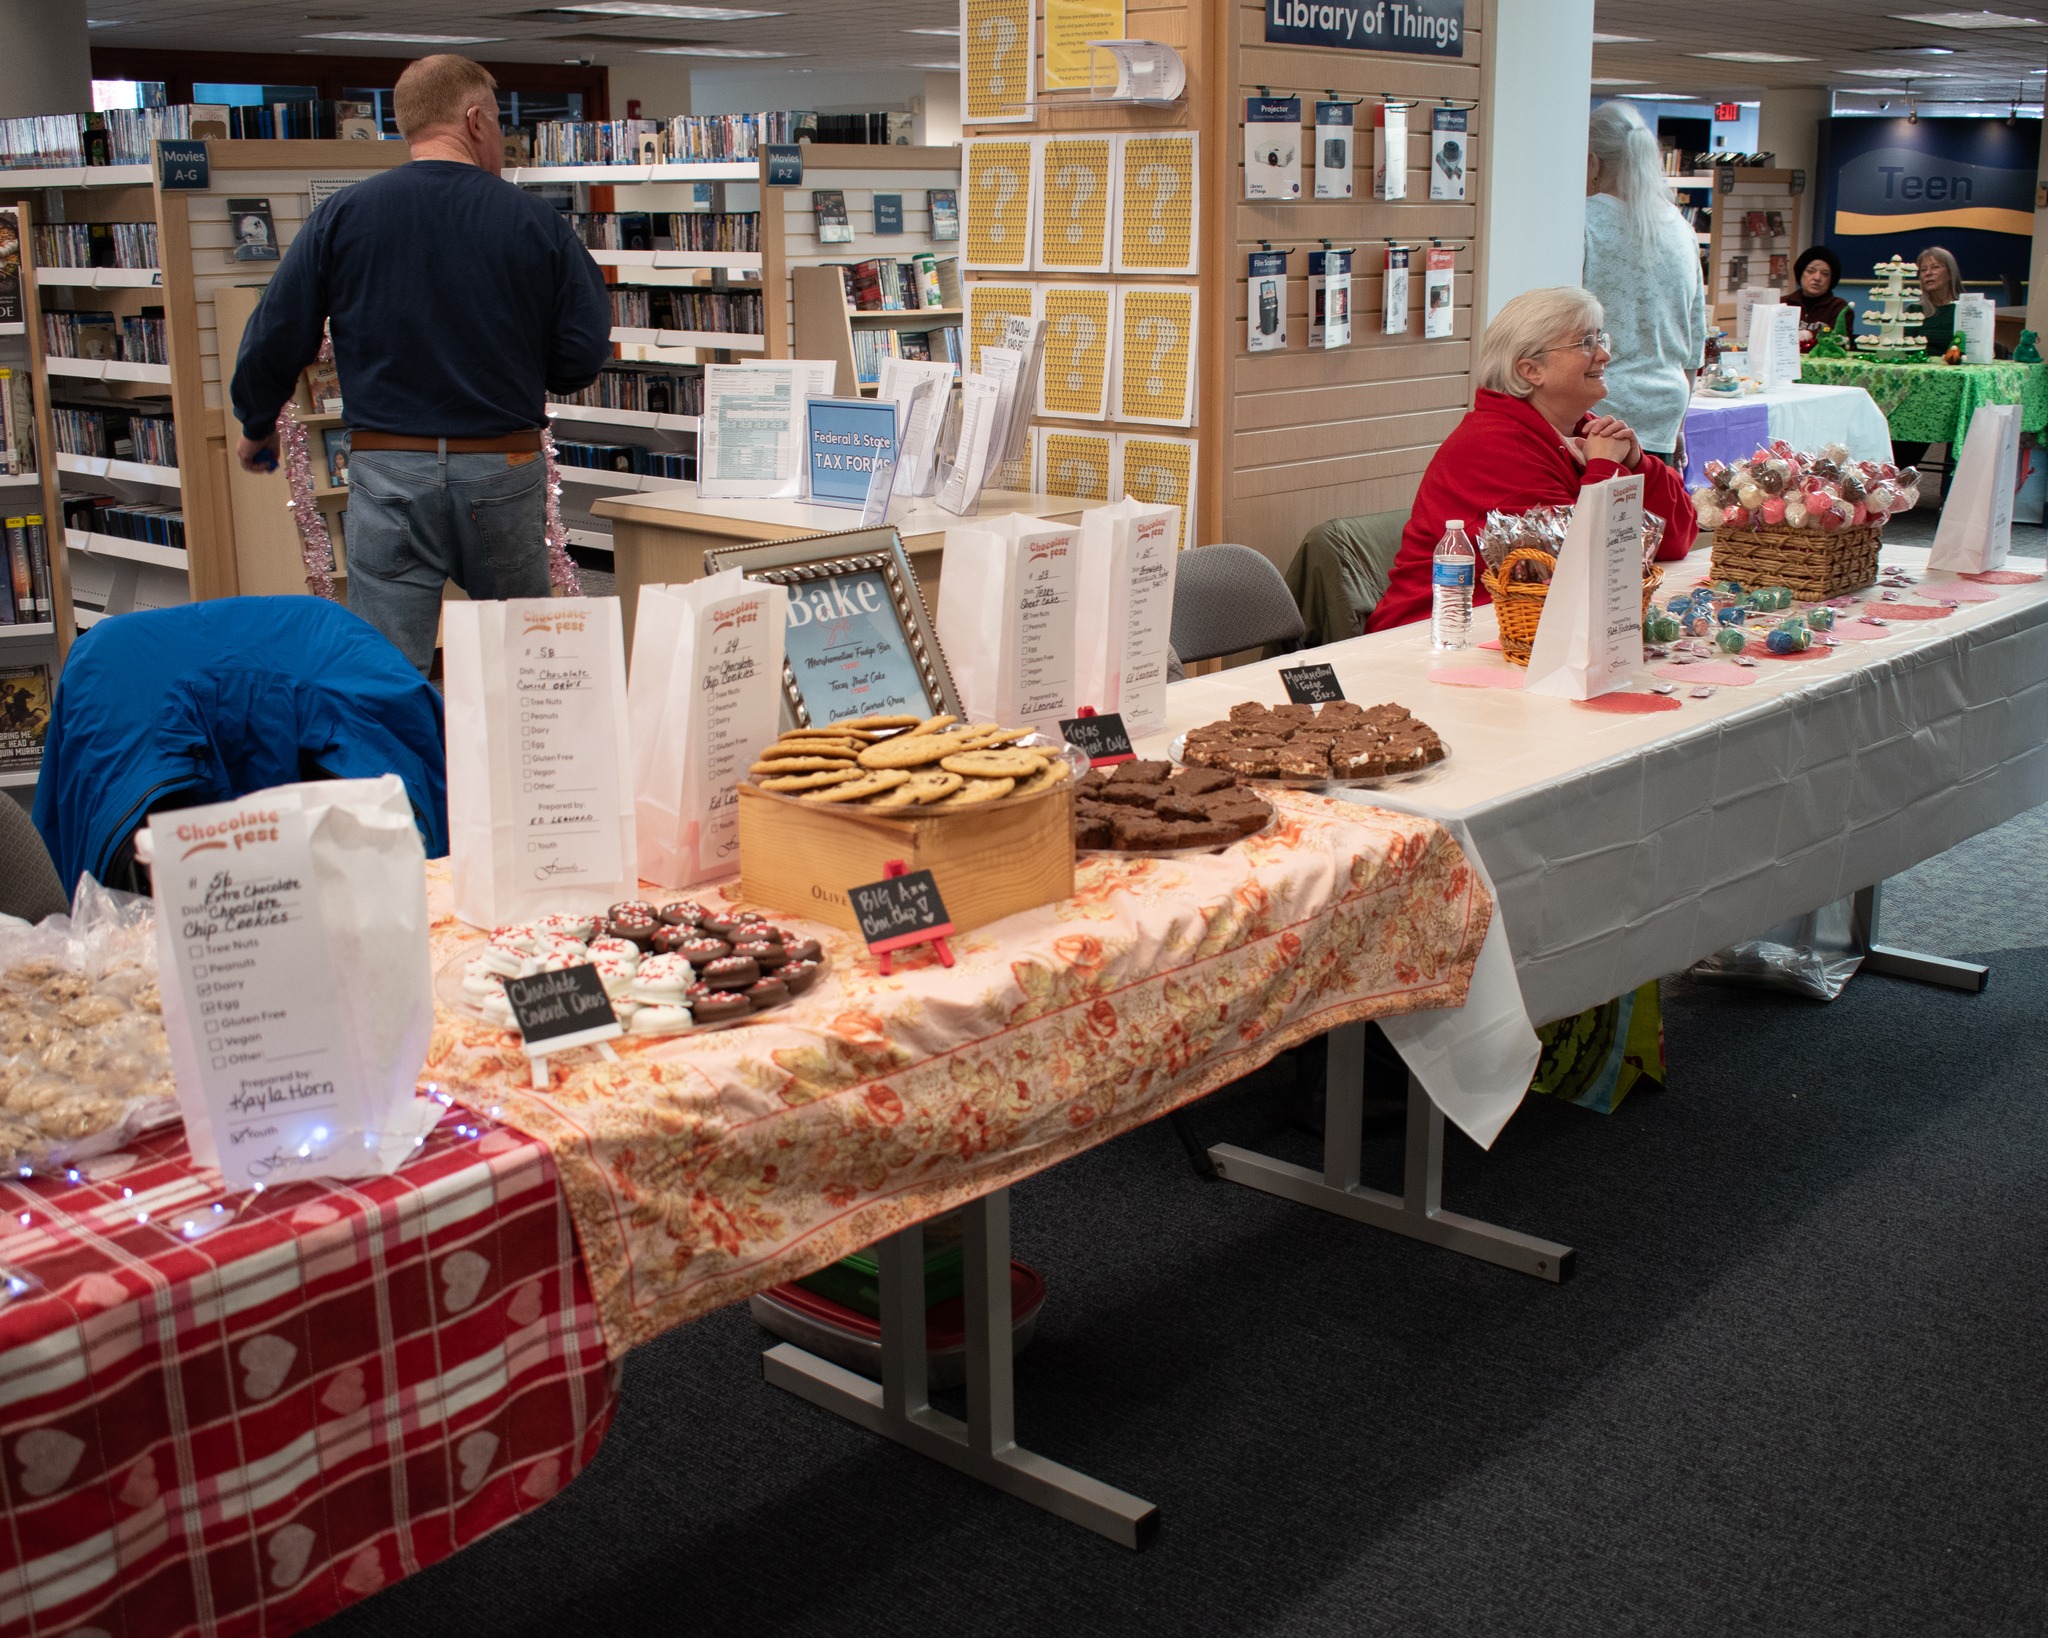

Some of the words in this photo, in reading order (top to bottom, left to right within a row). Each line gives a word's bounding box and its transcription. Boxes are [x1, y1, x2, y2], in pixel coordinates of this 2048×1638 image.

[1273, 0, 1358, 40] Library
[1363, 2, 1384, 34] of
[1391, 4, 1458, 48] Things
[1261, 105, 1288, 114] Projector
[1719, 103, 1737, 121] EXIT
[164, 150, 206, 162] Movies
[771, 153, 800, 163] Movies
[174, 169, 198, 181] A-G
[778, 169, 793, 179] P-Z
[1878, 166, 1973, 201] Teen
[880, 205, 896, 214] Binge
[880, 216, 897, 224] Boxes
[1264, 259, 1282, 267] Scanner
[1010, 320, 1024, 336] 1040
[318, 367, 335, 376] SOLO
[814, 430, 851, 445] Federal
[853, 433, 862, 447] &
[863, 433, 891, 449] State
[815, 452, 843, 470] TAX
[846, 455, 891, 473] FORMS
[1138, 518, 1166, 533] Chocolate
[1029, 537, 1070, 552] Chocolate
[786, 577, 881, 628] Bake
[523, 609, 588, 622] Chocolate
[713, 600, 760, 622] Chocolate
[736, 612, 757, 628] fest
[725, 638, 740, 654] 24
[855, 646, 876, 660] Fudge
[876, 642, 891, 654] Bar
[520, 667, 535, 675] Dish:
[540, 669, 590, 679] Chocolate
[720, 657, 754, 675] Chocolate
[720, 669, 755, 685] Cookies
[828, 680, 849, 692] Texas
[870, 671, 887, 683] Cake
[728, 688, 740, 696] Nuts
[1299, 680, 1325, 692] Fudge
[530, 698, 545, 706] Tree
[545, 697, 562, 706] Nuts
[1029, 692, 1052, 701] Prepared
[1311, 690, 1336, 702] Bars
[716, 702, 737, 712] Peanuts
[860, 699, 885, 714] Covered
[887, 695, 906, 707] Oreos
[1020, 703, 1032, 715] Ed
[1033, 697, 1064, 713] Leonard
[530, 712, 559, 721] Peanuts
[716, 717, 731, 725] Dairy
[21, 731, 32, 739] ME
[531, 726, 550, 735] Dairy
[716, 731, 727, 739] Egg
[1065, 722, 1100, 744] Texas
[9, 739, 27, 748] HEAD
[532, 741, 546, 750] Egg
[716, 742, 735, 751] Gluten
[1106, 734, 1130, 752] Cake
[532, 754, 556, 763] Gluten
[557, 753, 574, 761] Free
[716, 754, 735, 763] Vegan
[532, 769, 556, 778] Vegan
[533, 783, 556, 791] Other:
[538, 802, 573, 812] Prepared
[709, 795, 721, 811] Ed
[177, 810, 279, 842] Chocolate
[234, 827, 279, 851] fest
[538, 841, 558, 850] Youth
[205, 889, 240, 906] Extra
[243, 878, 302, 898] Chocolate
[858, 887, 894, 912] BIG
[209, 898, 282, 920] Chocolate
[183, 920, 218, 942] Chip
[225, 911, 289, 933] Cookies
[206, 943, 231, 954] Tree
[233, 939, 259, 950] Nuts
[209, 958, 256, 973] Peanuts
[213, 979, 244, 993] Dairy
[510, 971, 582, 1006] Chocolate
[217, 1000, 240, 1011] Egg
[519, 996, 570, 1028] Covered
[570, 990, 606, 1015] Oreos
[221, 1014, 260, 1029] Gluten
[261, 1010, 288, 1021] Free
[225, 1032, 263, 1046] Vegan
[229, 1051, 264, 1065] Other:
[241, 1072, 293, 1088] Prepared
[229, 1084, 288, 1114] Kayla
[289, 1080, 334, 1100] Horn
[249, 1125, 279, 1138] Youth
